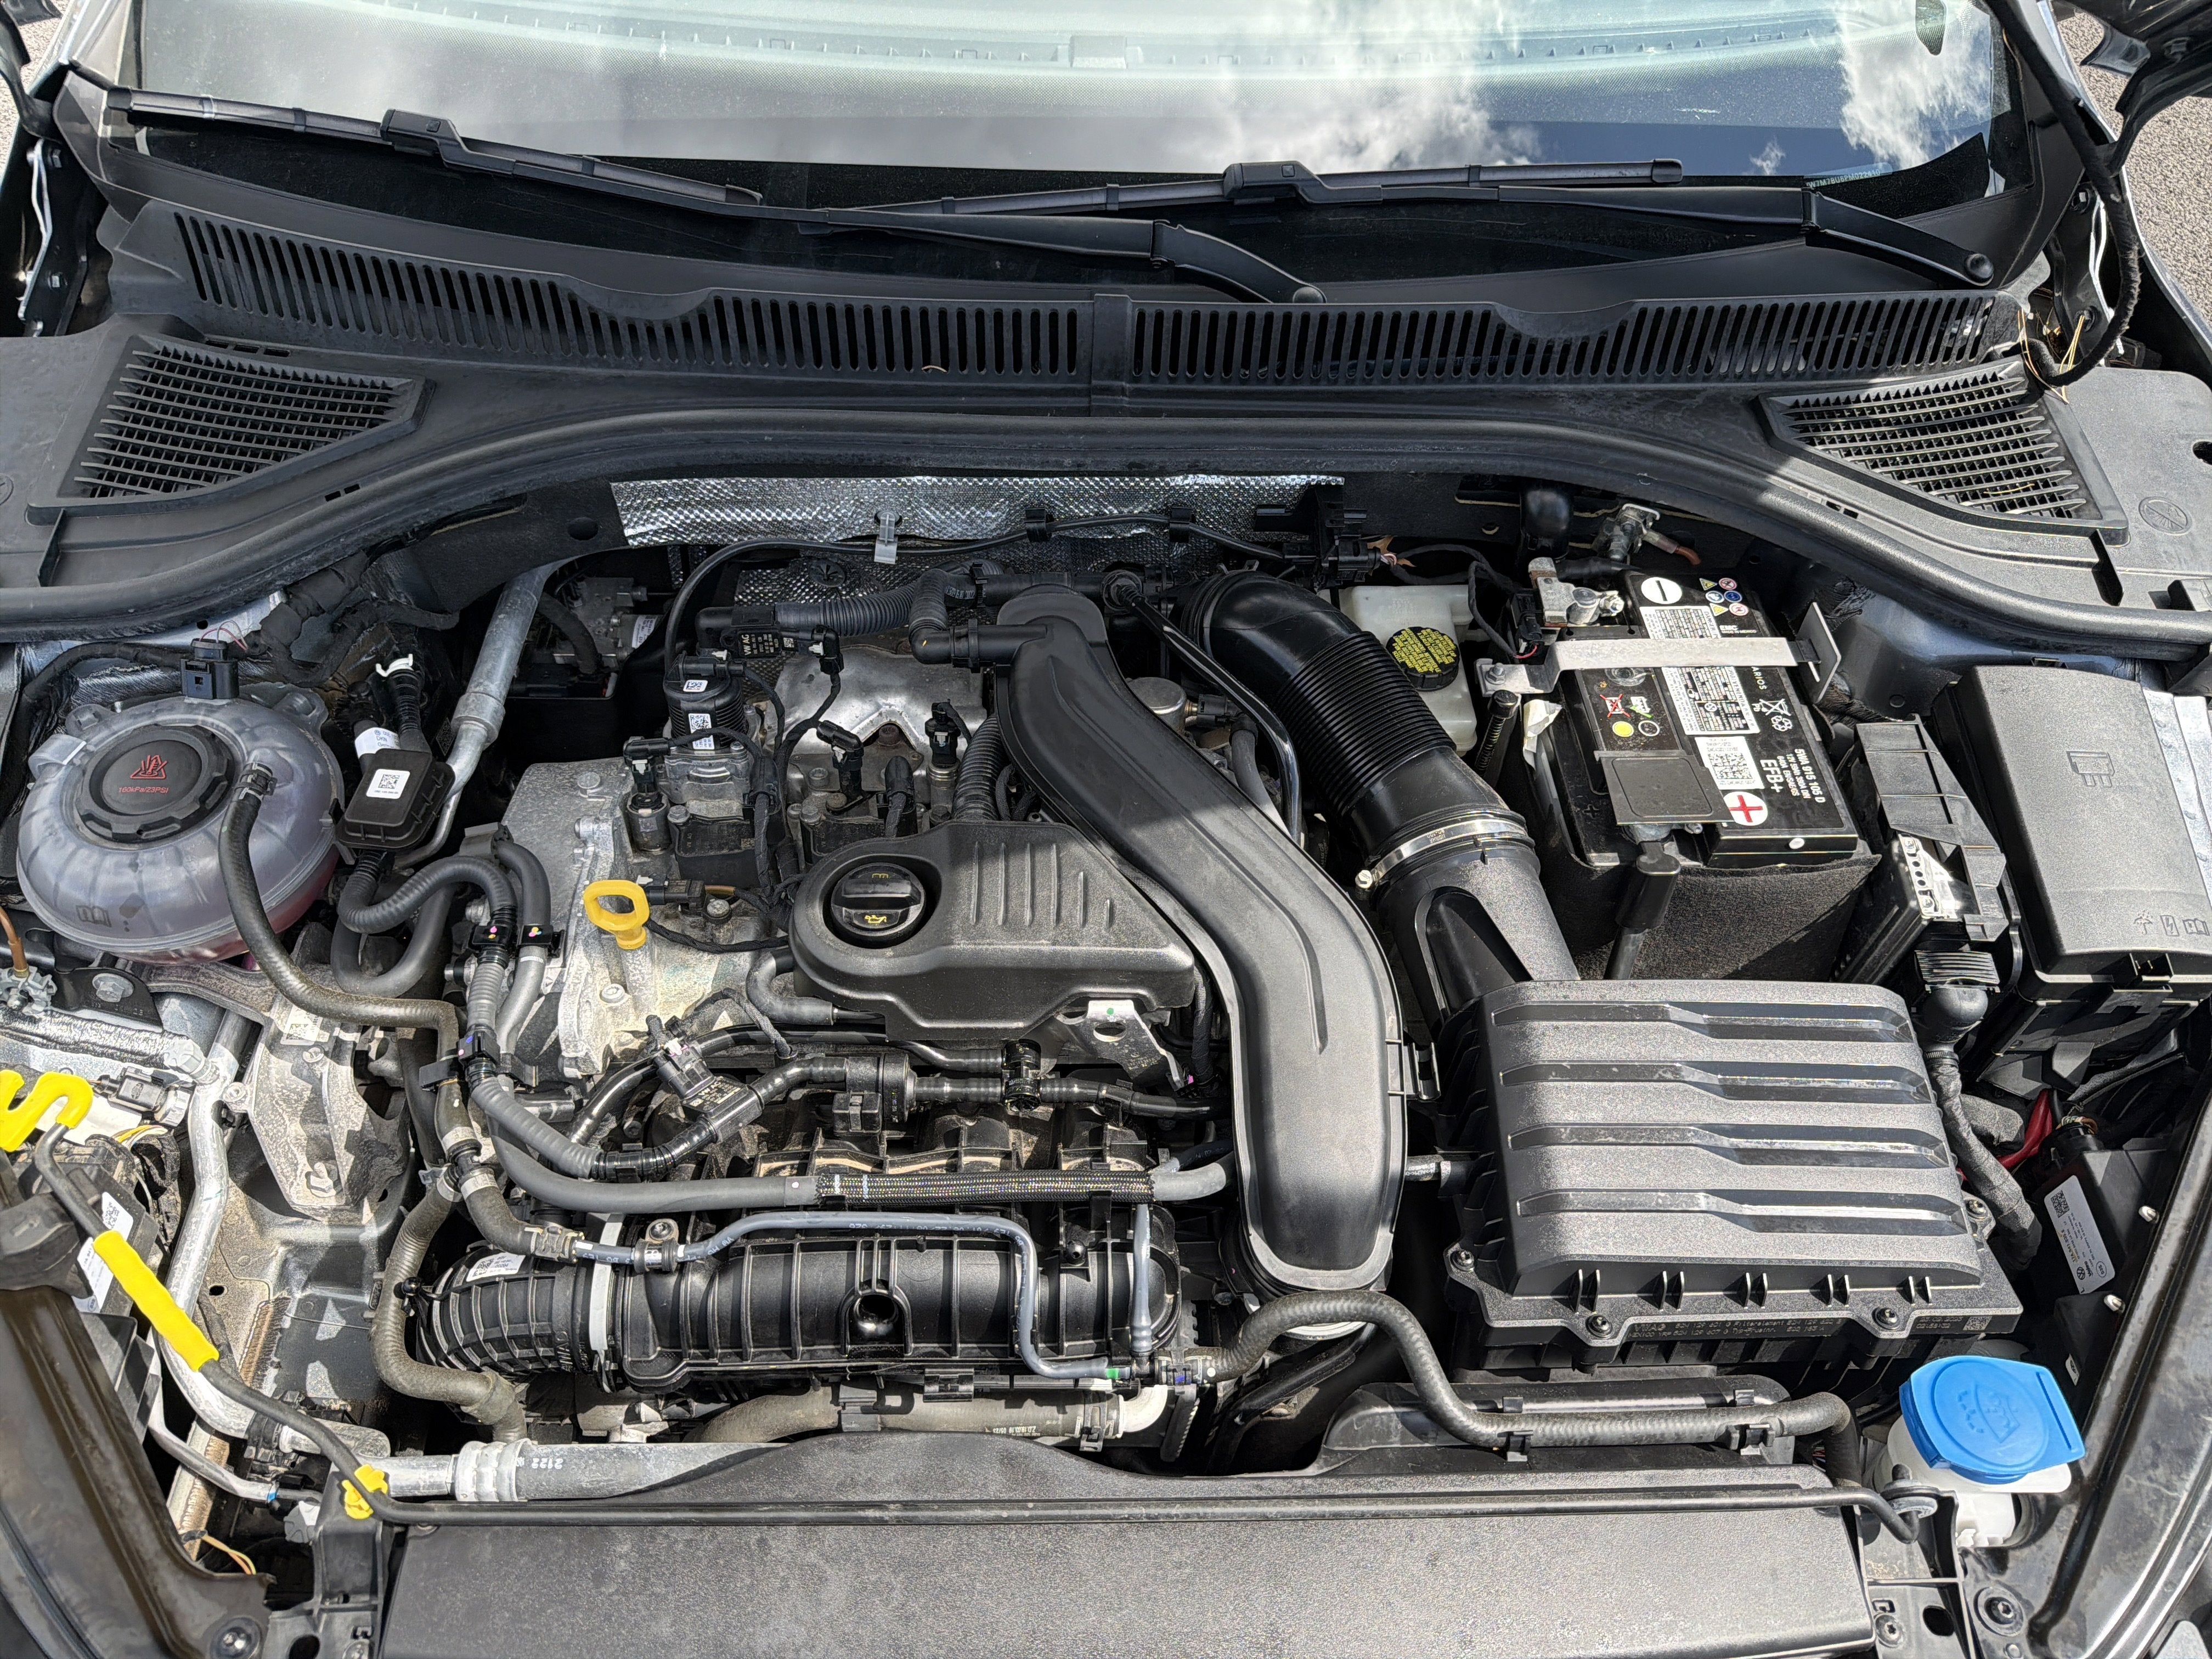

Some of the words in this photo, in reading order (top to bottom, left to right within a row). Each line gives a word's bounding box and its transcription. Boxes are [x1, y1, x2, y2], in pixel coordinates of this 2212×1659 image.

[741, 634, 751, 644] AG
[1433, 630, 1444, 641] CLEAN
[1440, 640, 1452, 651] FILLER
[743, 645, 752, 656] VW
[1752, 703, 1761, 712] Pb
[1794, 749, 1810, 765] 5WA
[1759, 759, 1785, 793] EFB+
[1802, 766, 1816, 781] 915
[1800, 790, 1812, 799] DIN
[1808, 781, 1823, 796] 105
